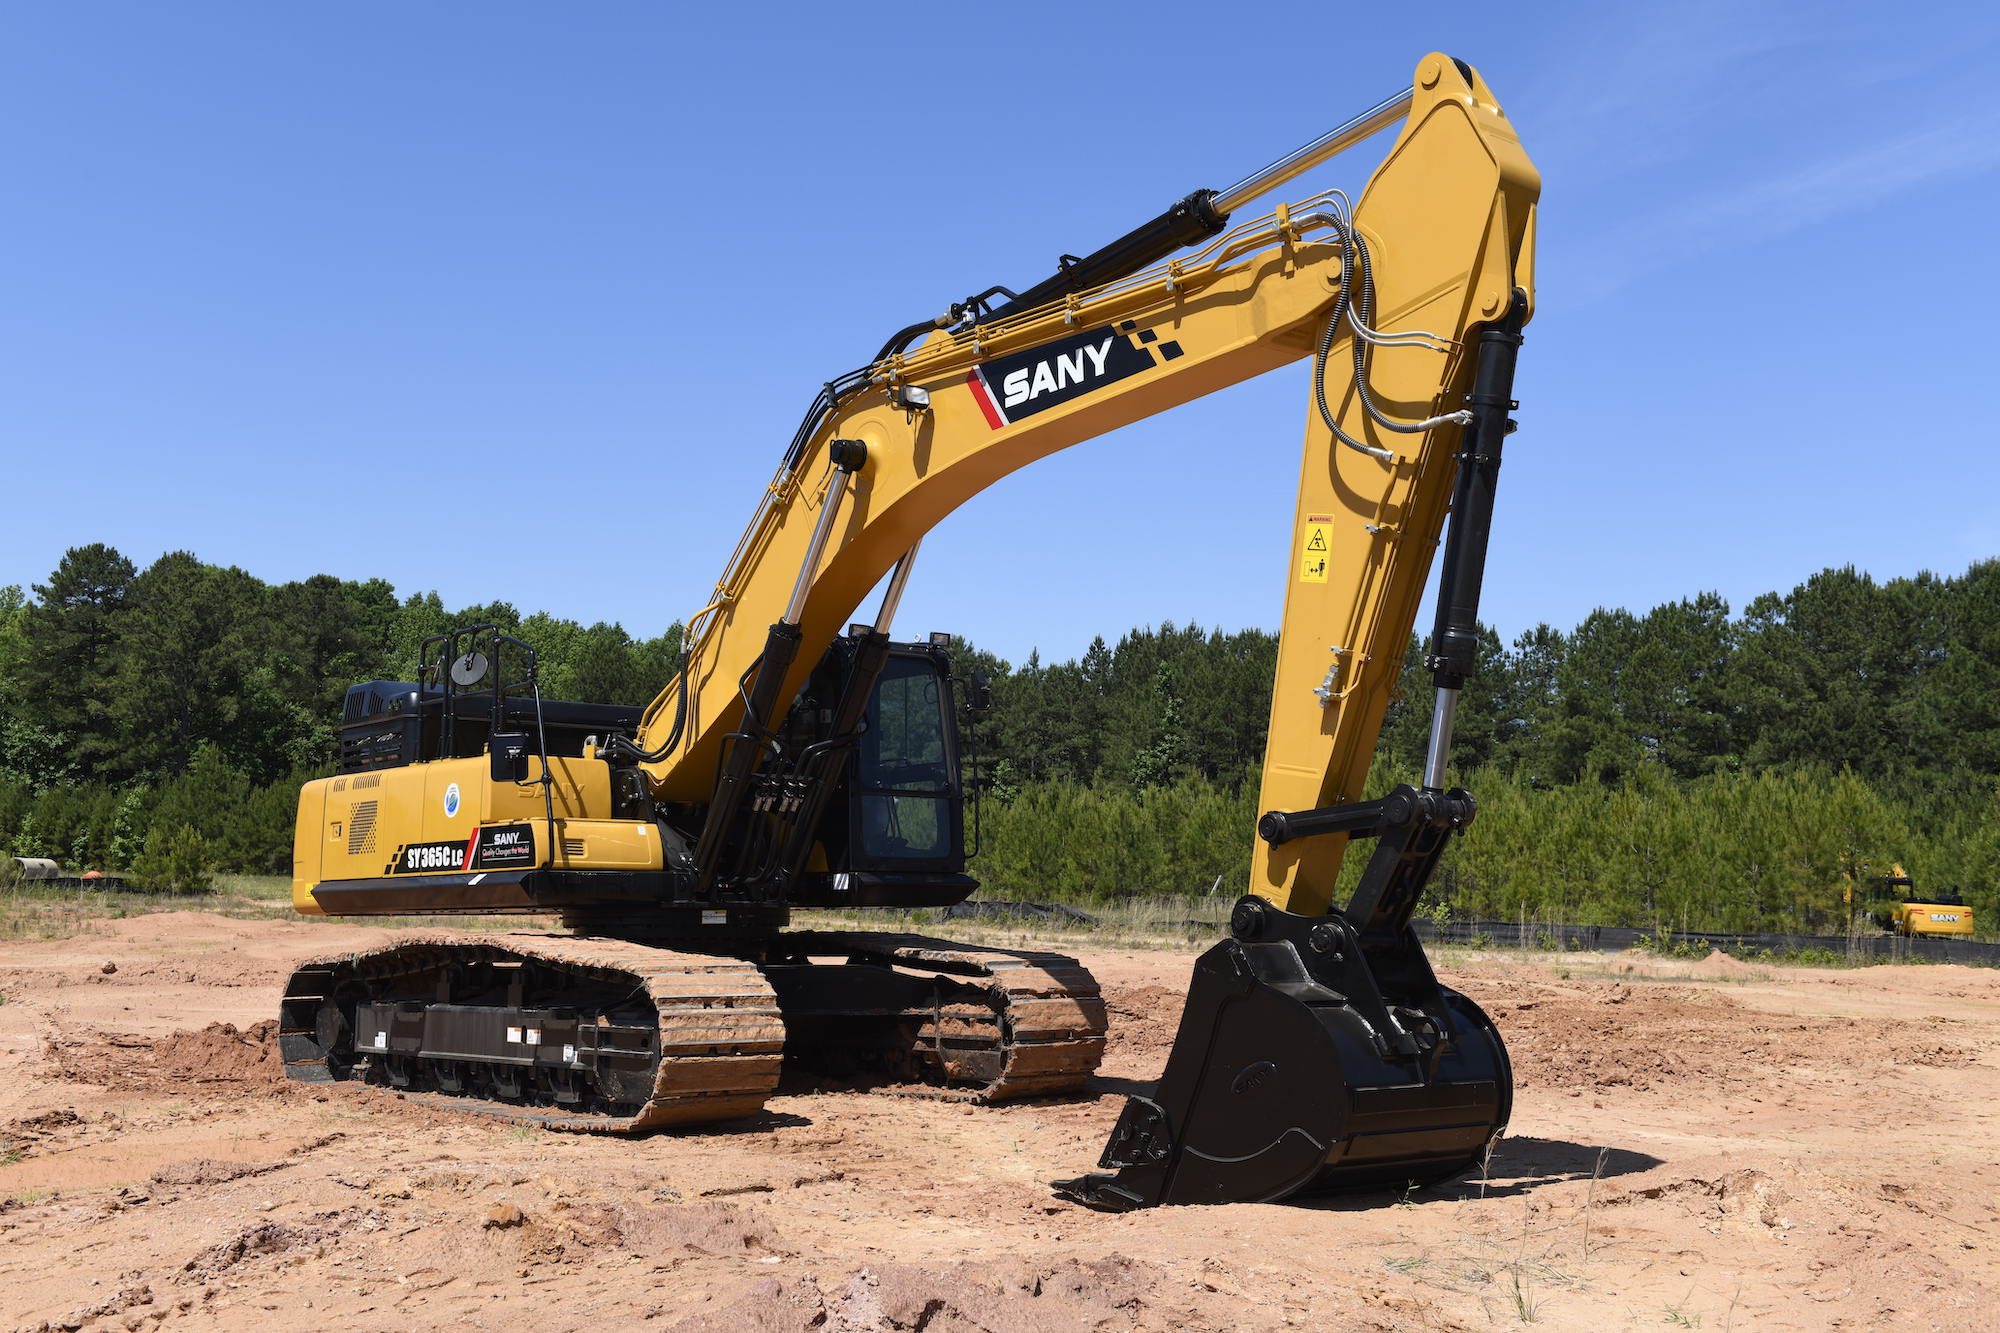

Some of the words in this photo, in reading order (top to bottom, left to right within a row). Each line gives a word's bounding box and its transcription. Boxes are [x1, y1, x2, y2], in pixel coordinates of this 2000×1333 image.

[1003, 336, 1114, 408] SANY
[494, 832, 520, 845] SANY
[482, 848, 495, 857] Quality
[495, 847, 511, 857] Changes
[518, 844, 530, 854] World
[1930, 914, 1959, 922] SANY
